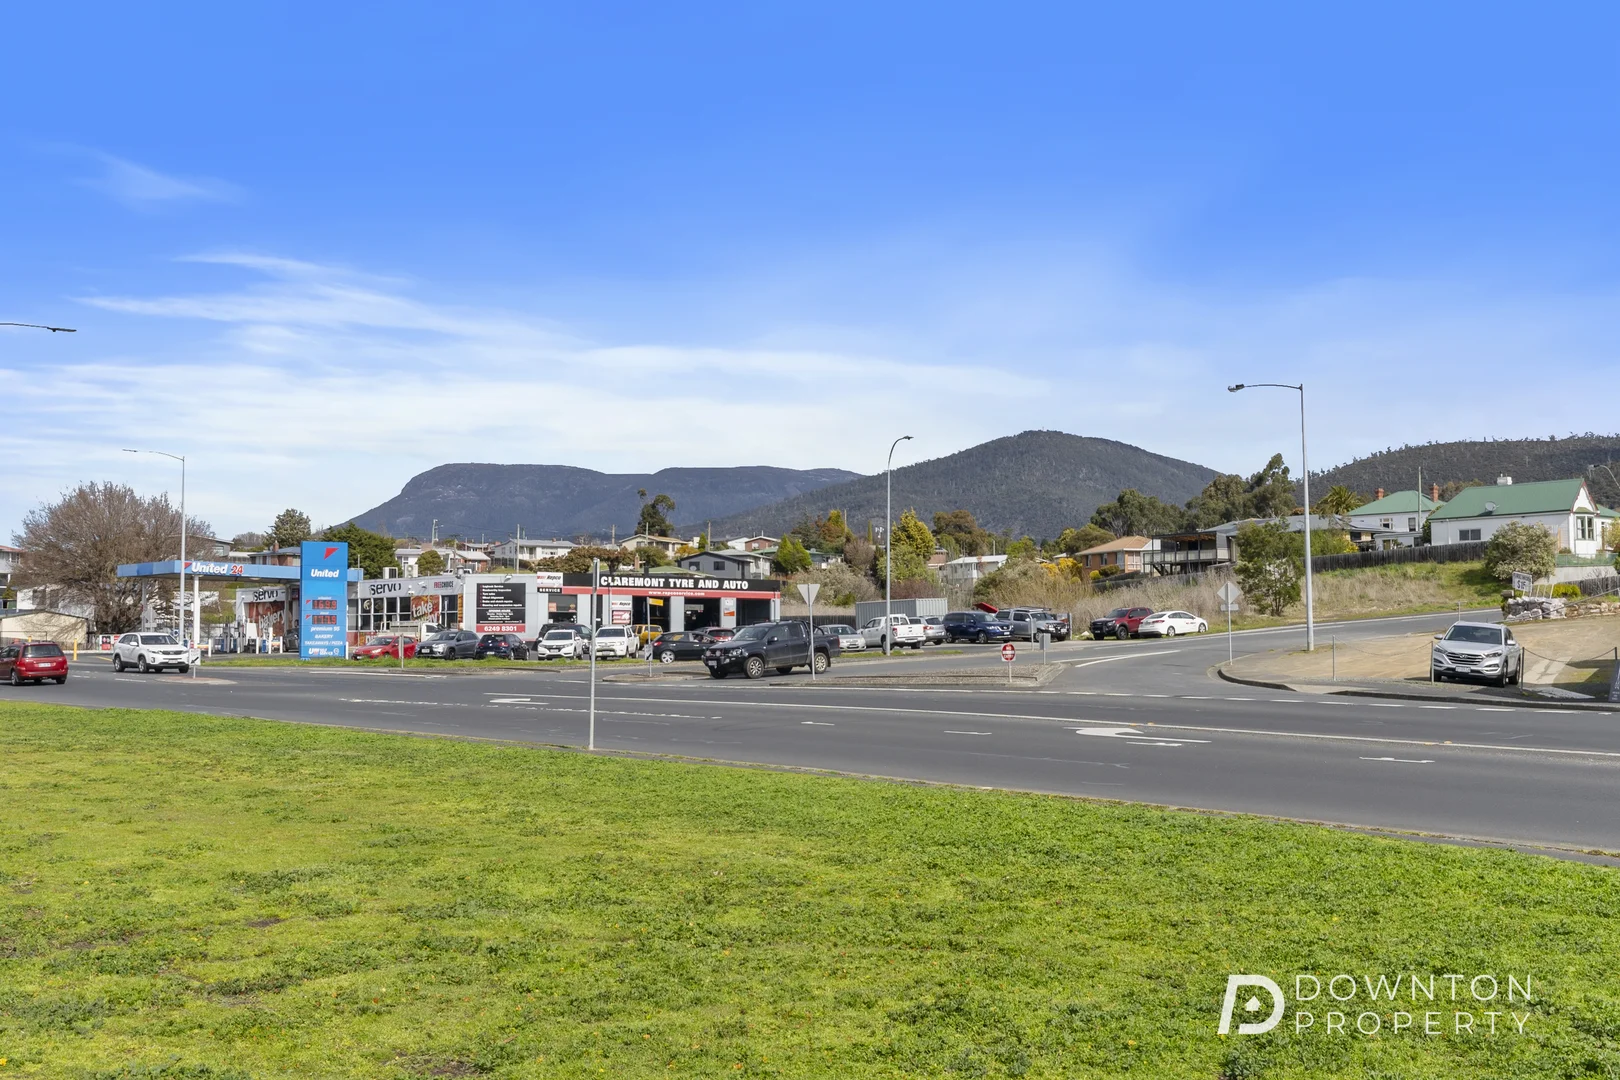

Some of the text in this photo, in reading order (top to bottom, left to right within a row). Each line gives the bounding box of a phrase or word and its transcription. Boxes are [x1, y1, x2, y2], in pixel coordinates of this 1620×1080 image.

[191, 561, 244, 575] United 24
[310, 568, 340, 578] United
[370, 582, 402, 596] servo
[600, 576, 749, 590] CLAREMONT TYRE AND AUTO
[412, 600, 433, 618] take
